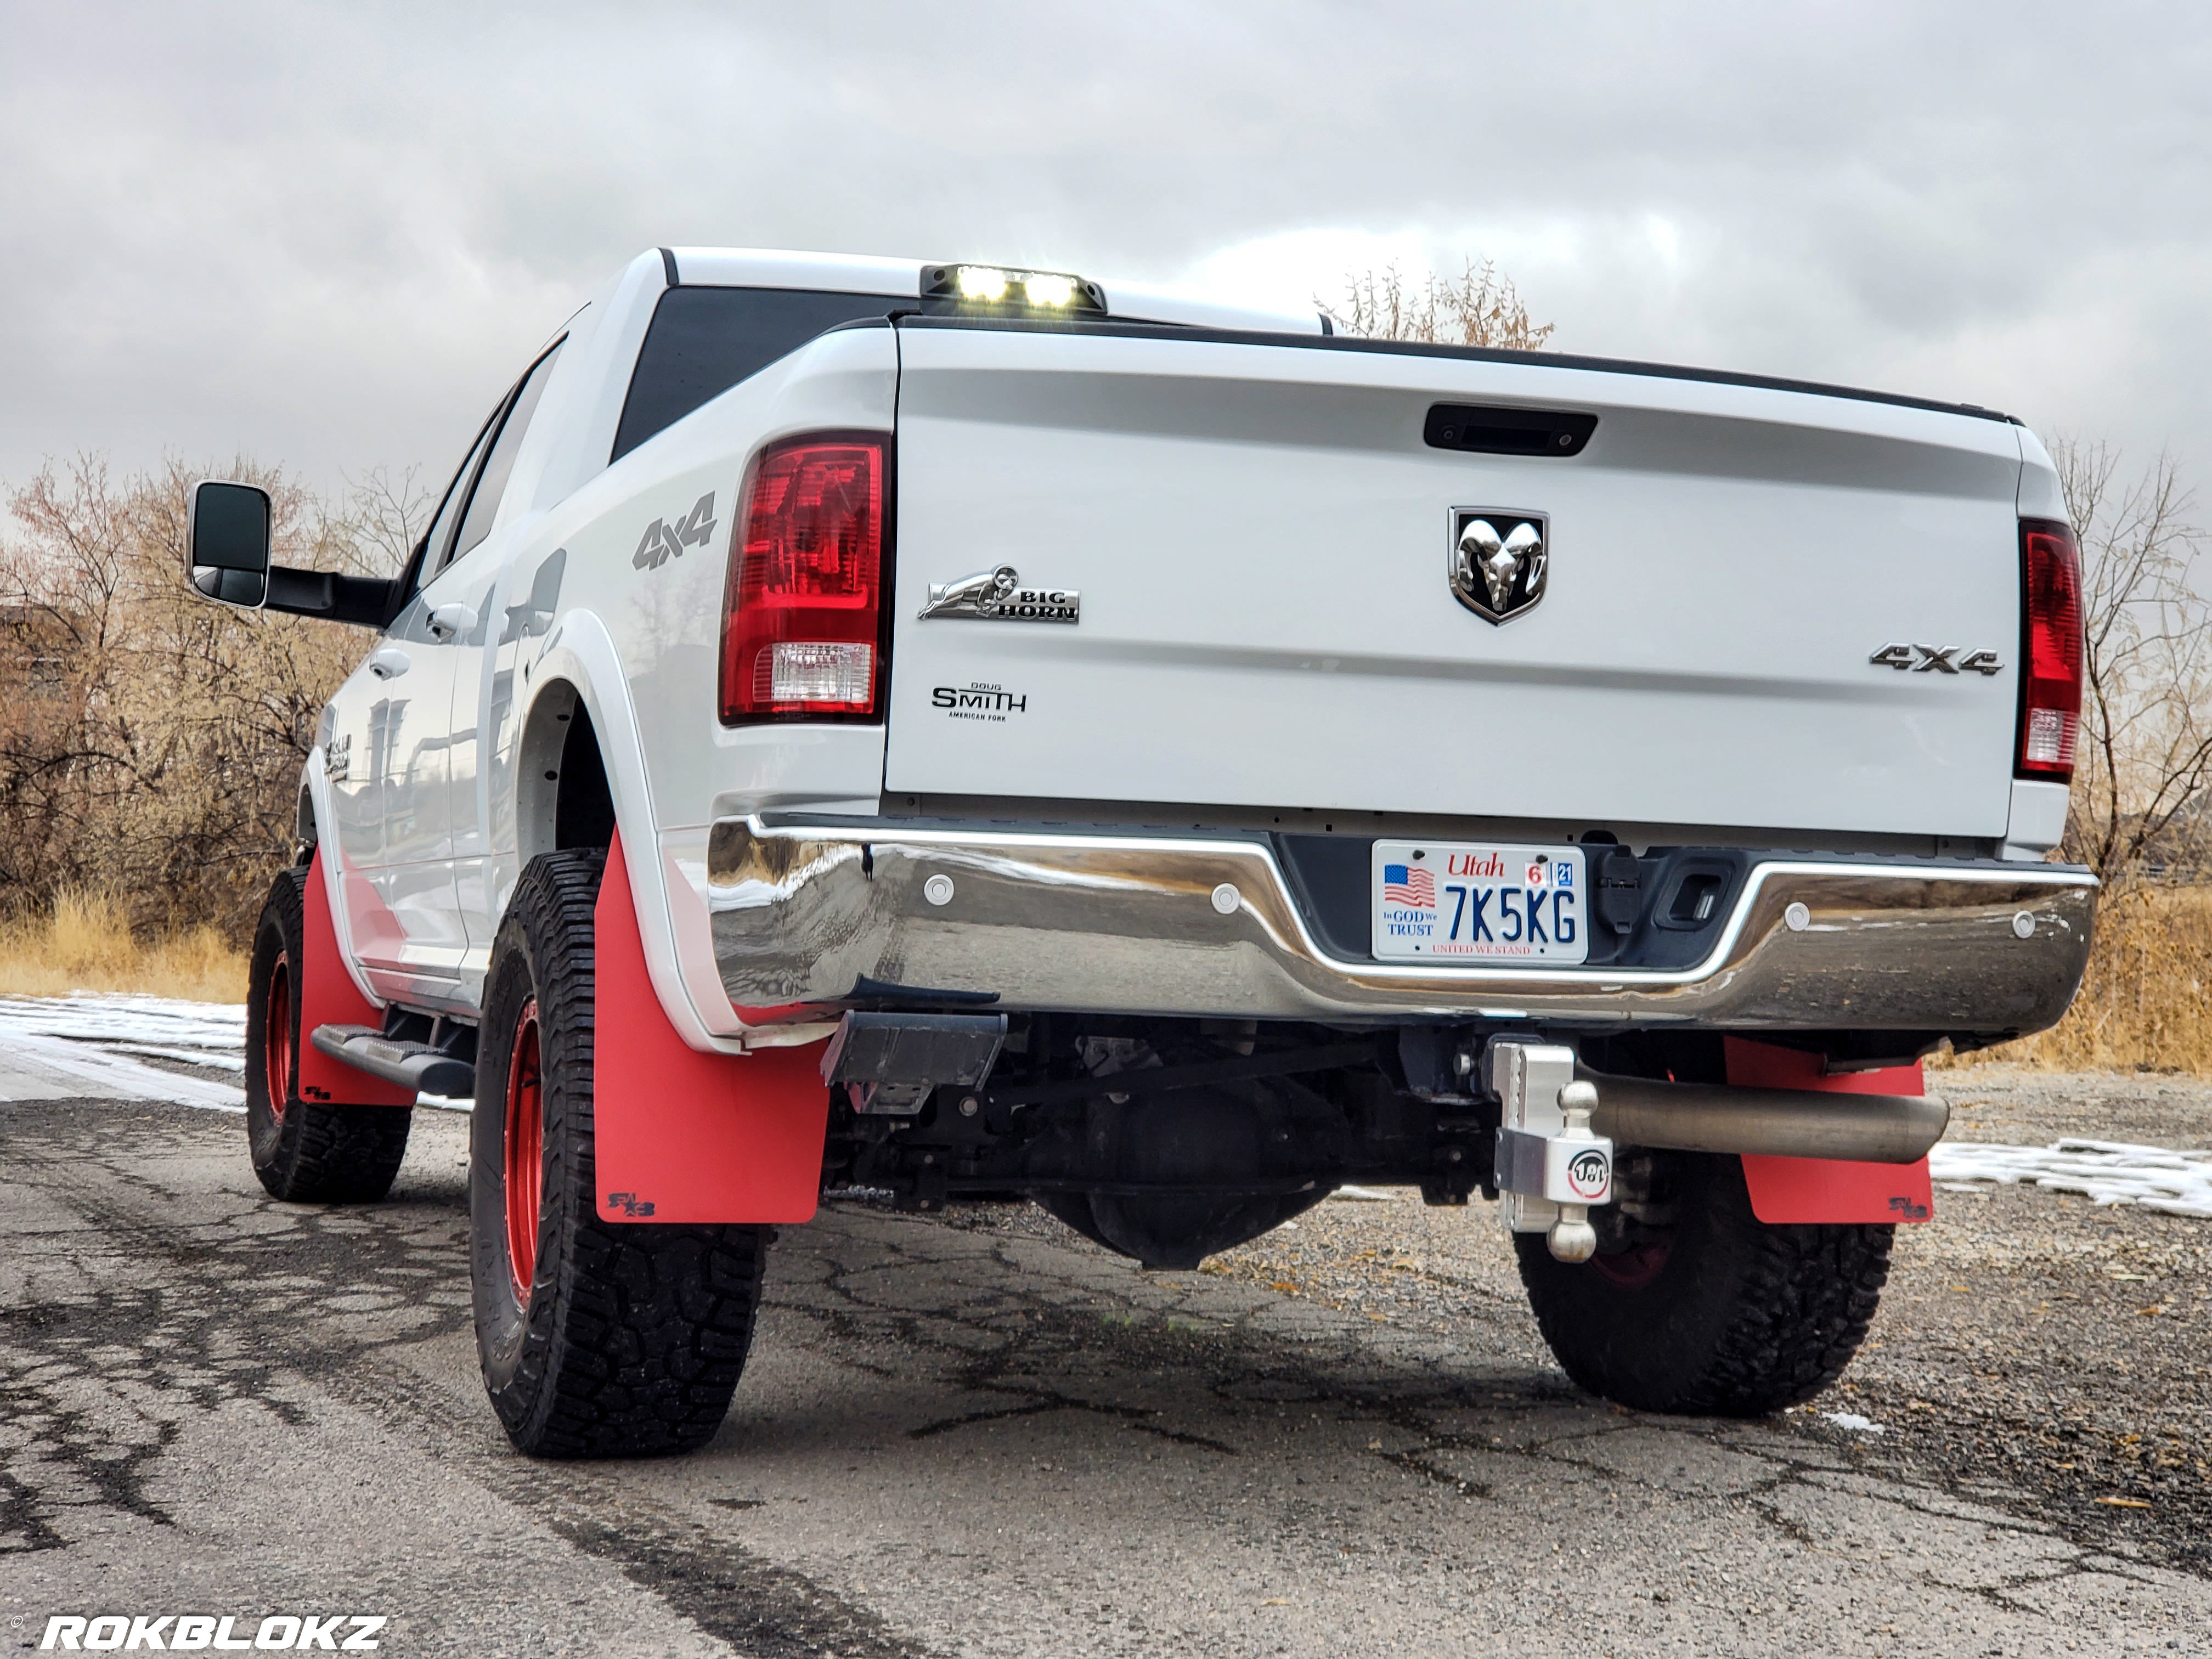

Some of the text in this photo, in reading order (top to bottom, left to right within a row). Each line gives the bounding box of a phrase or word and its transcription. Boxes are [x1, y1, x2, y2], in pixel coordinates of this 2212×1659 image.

[1020, 591, 1066, 603] BIG
[998, 605, 1076, 619] HORN
[972, 682, 1001, 690] DOUG
[949, 712, 985, 721] AMERICAN
[1448, 852, 1504, 877] Utah
[1528, 865, 1542, 884] 6
[1559, 865, 1572, 880] 21
[1394, 911, 1424, 922] GOD
[1446, 886, 1575, 943] 7K5KG
[1387, 924, 1433, 936] TRUST
[1432, 945, 1530, 955] UNITED WE STAND
